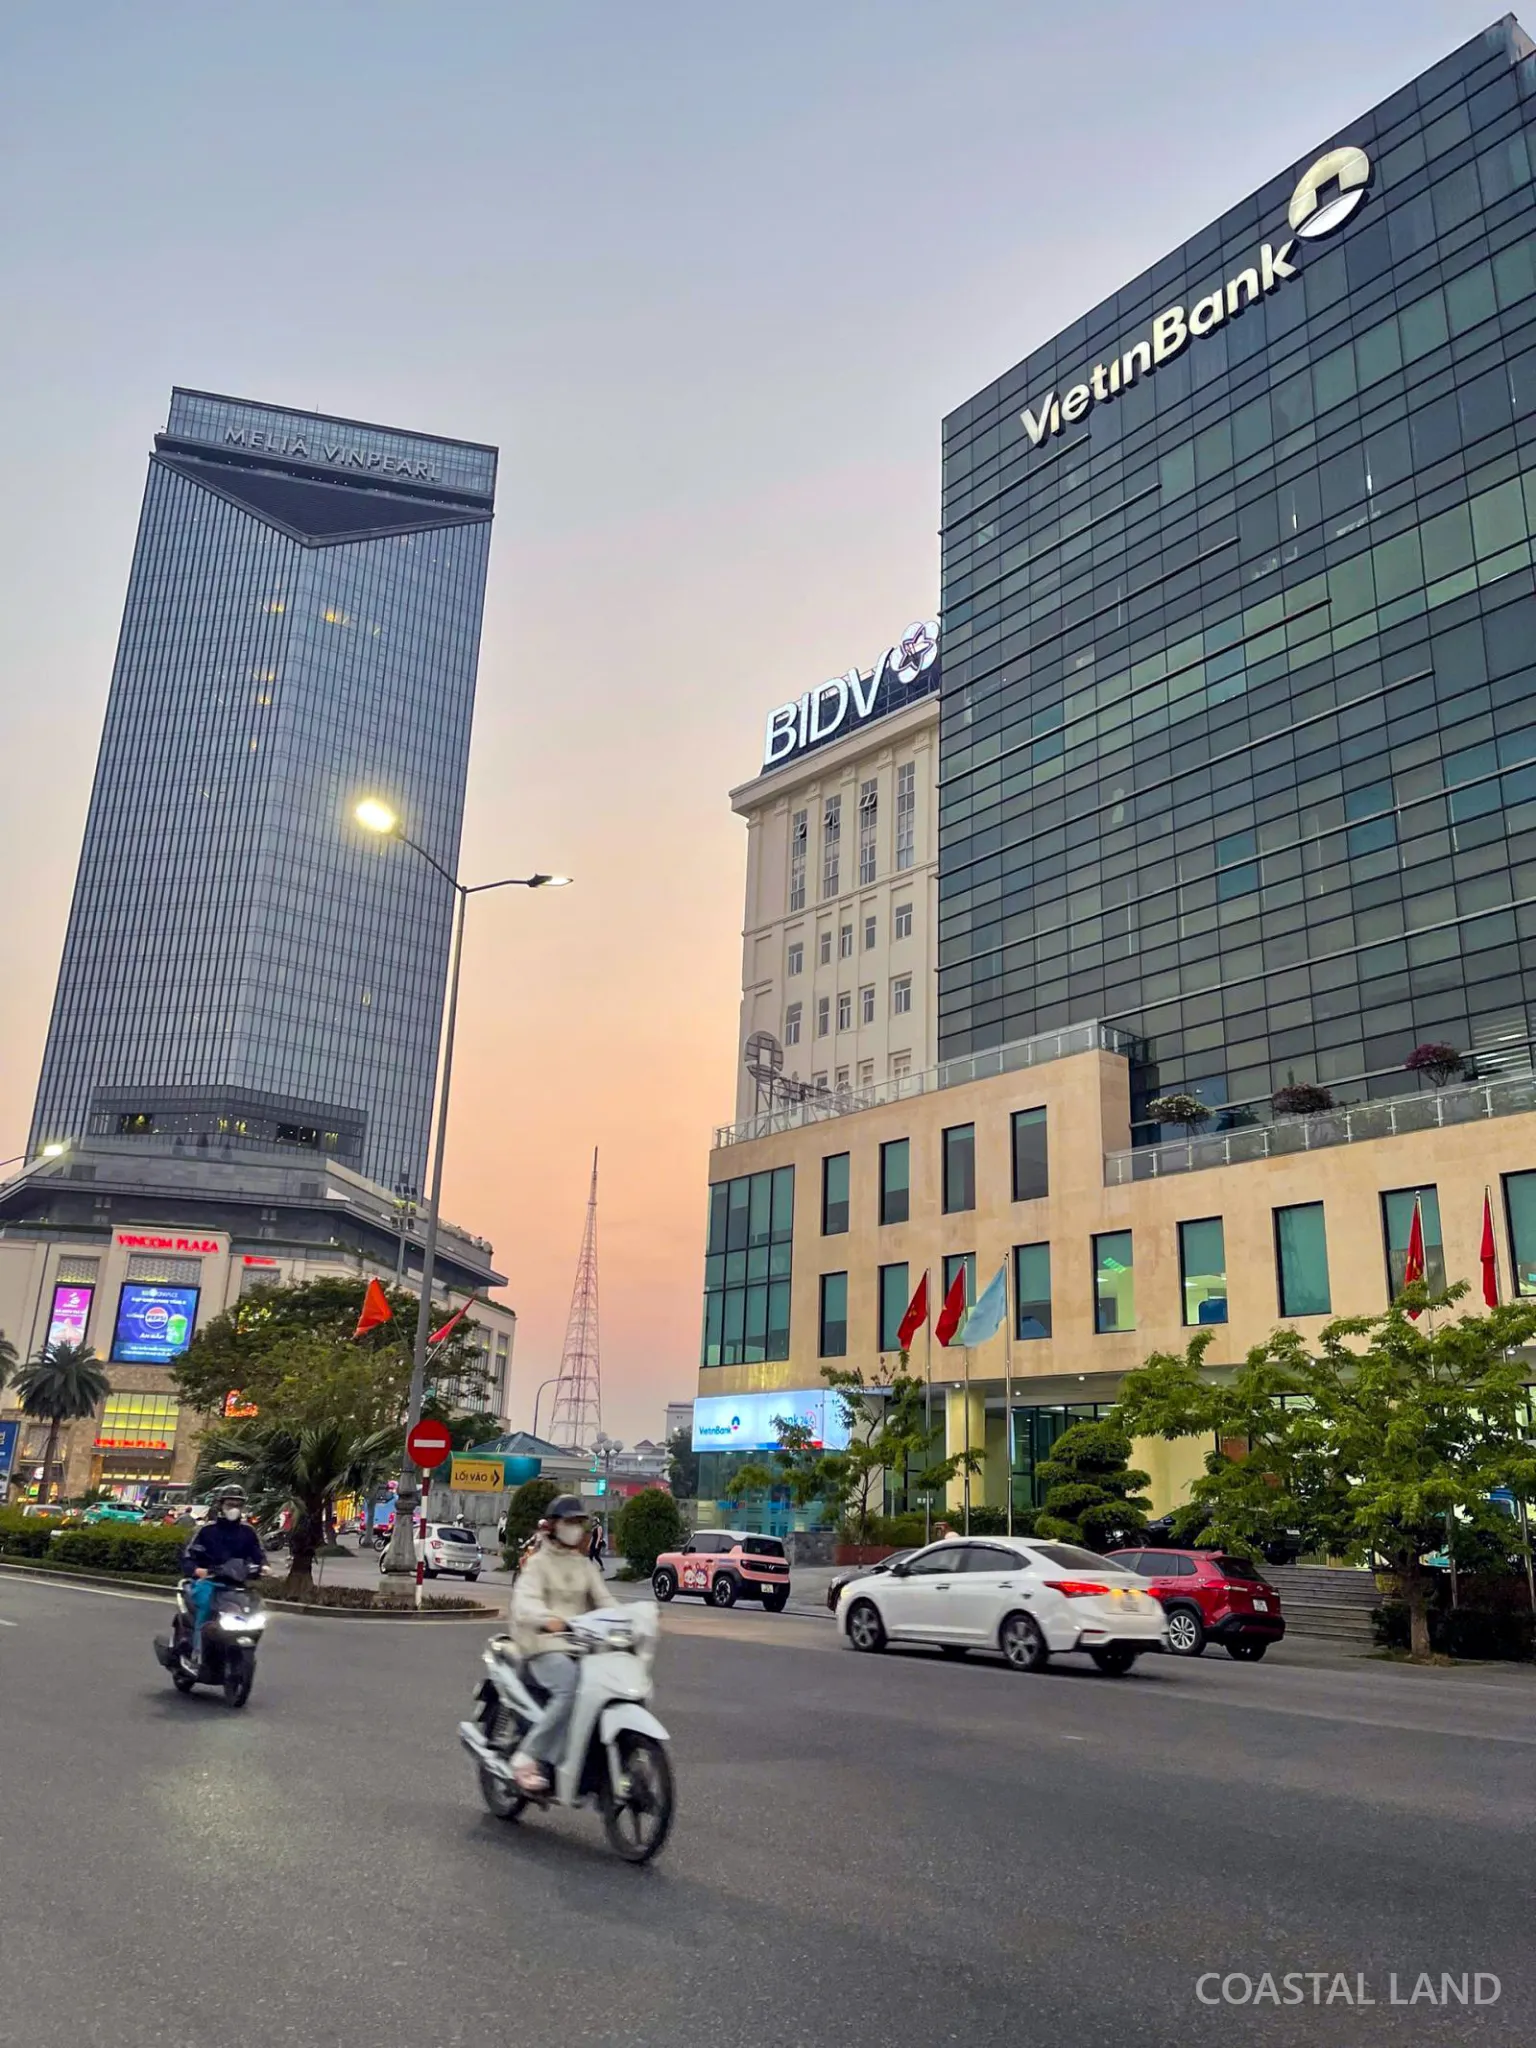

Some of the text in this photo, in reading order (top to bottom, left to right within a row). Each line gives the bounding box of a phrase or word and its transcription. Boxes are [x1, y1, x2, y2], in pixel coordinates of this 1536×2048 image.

[1020, 239, 1298, 446] VietinBank
[323, 443, 442, 482] VINPEARL
[763, 647, 895, 766] BIDV
[117, 1235, 220, 1253] VINCOM PLAZA
